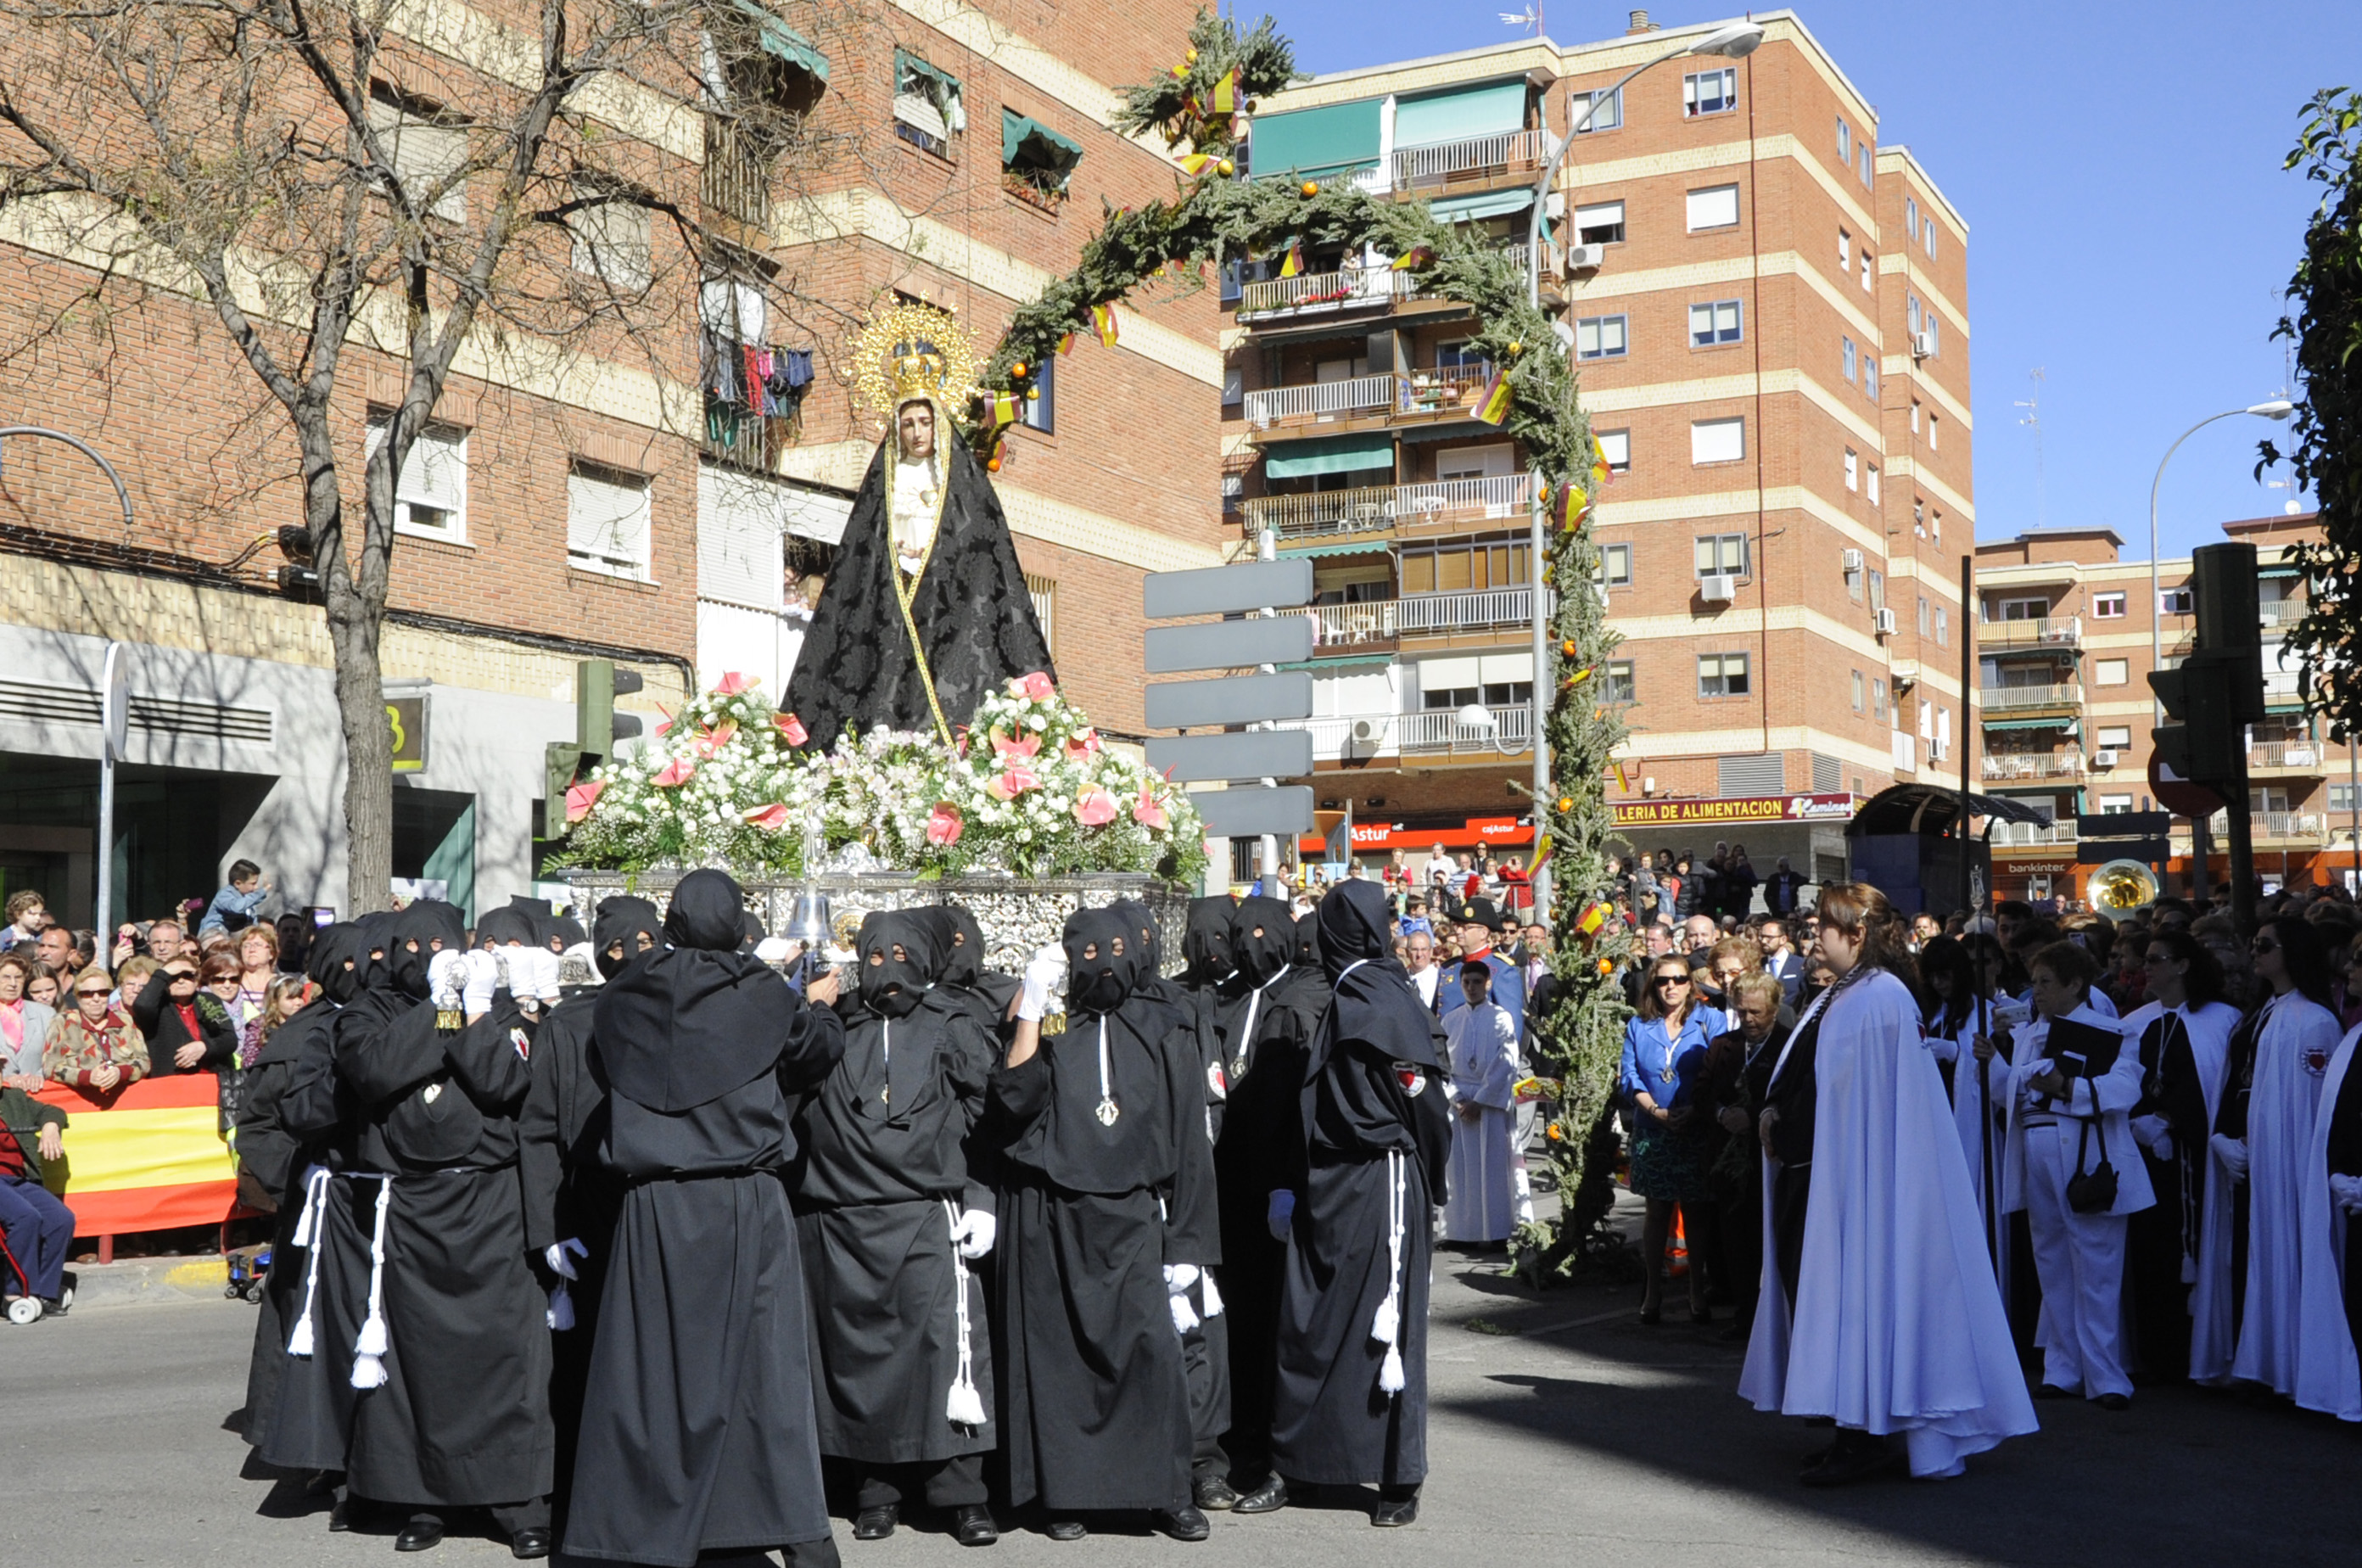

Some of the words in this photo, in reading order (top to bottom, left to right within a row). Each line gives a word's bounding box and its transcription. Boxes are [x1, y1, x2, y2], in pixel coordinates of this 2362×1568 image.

[1661, 804, 1678, 819] DE
[1682, 800, 1782, 818] ALIMENTACION
[1482, 824, 1514, 834] cajAstur
